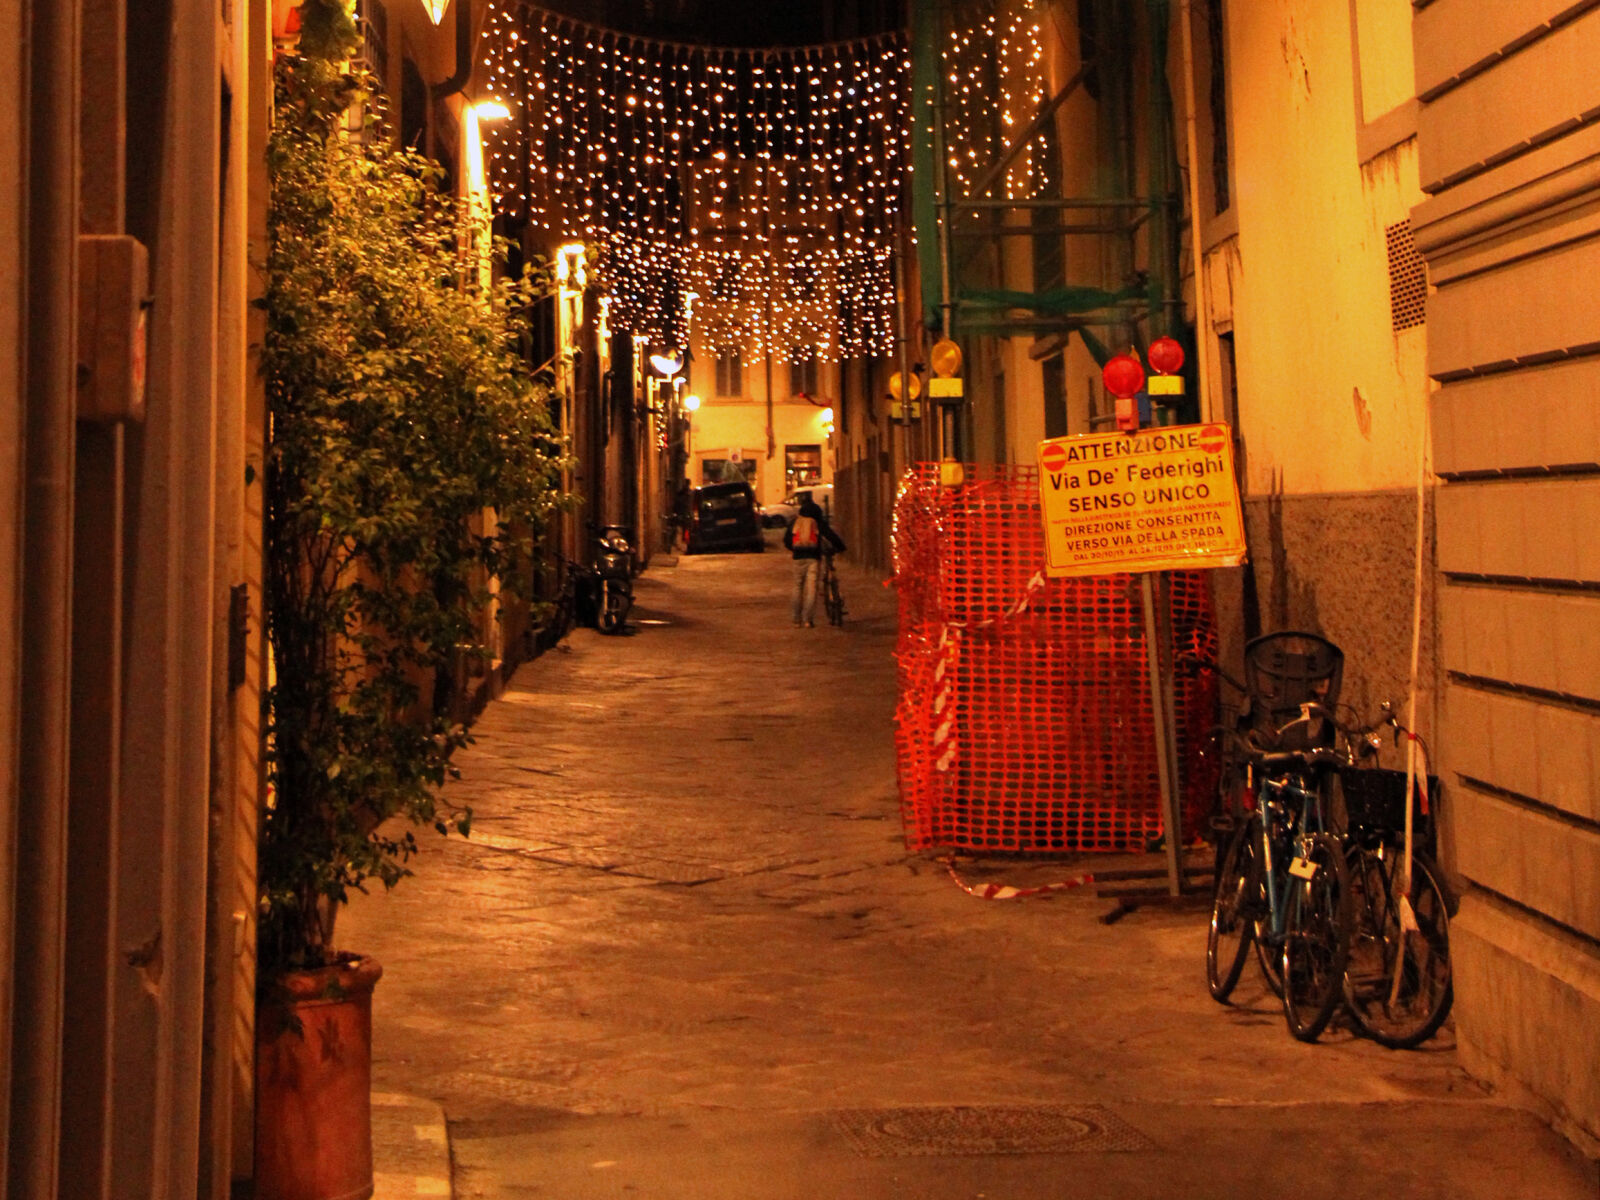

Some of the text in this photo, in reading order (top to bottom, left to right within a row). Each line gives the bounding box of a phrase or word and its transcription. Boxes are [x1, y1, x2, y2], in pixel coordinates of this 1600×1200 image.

[1067, 431, 1199, 462] ATTENZIONE
[1050, 455, 1225, 491] Via De' Federighi
[1069, 491, 1136, 513] SENSO
[1143, 483, 1210, 505] UNICO
[1065, 519, 1132, 537] DIREZIONE
[1136, 511, 1221, 529] CONSENTITA
[1067, 526, 1224, 551] VERSO VIA DELLA SPADA
